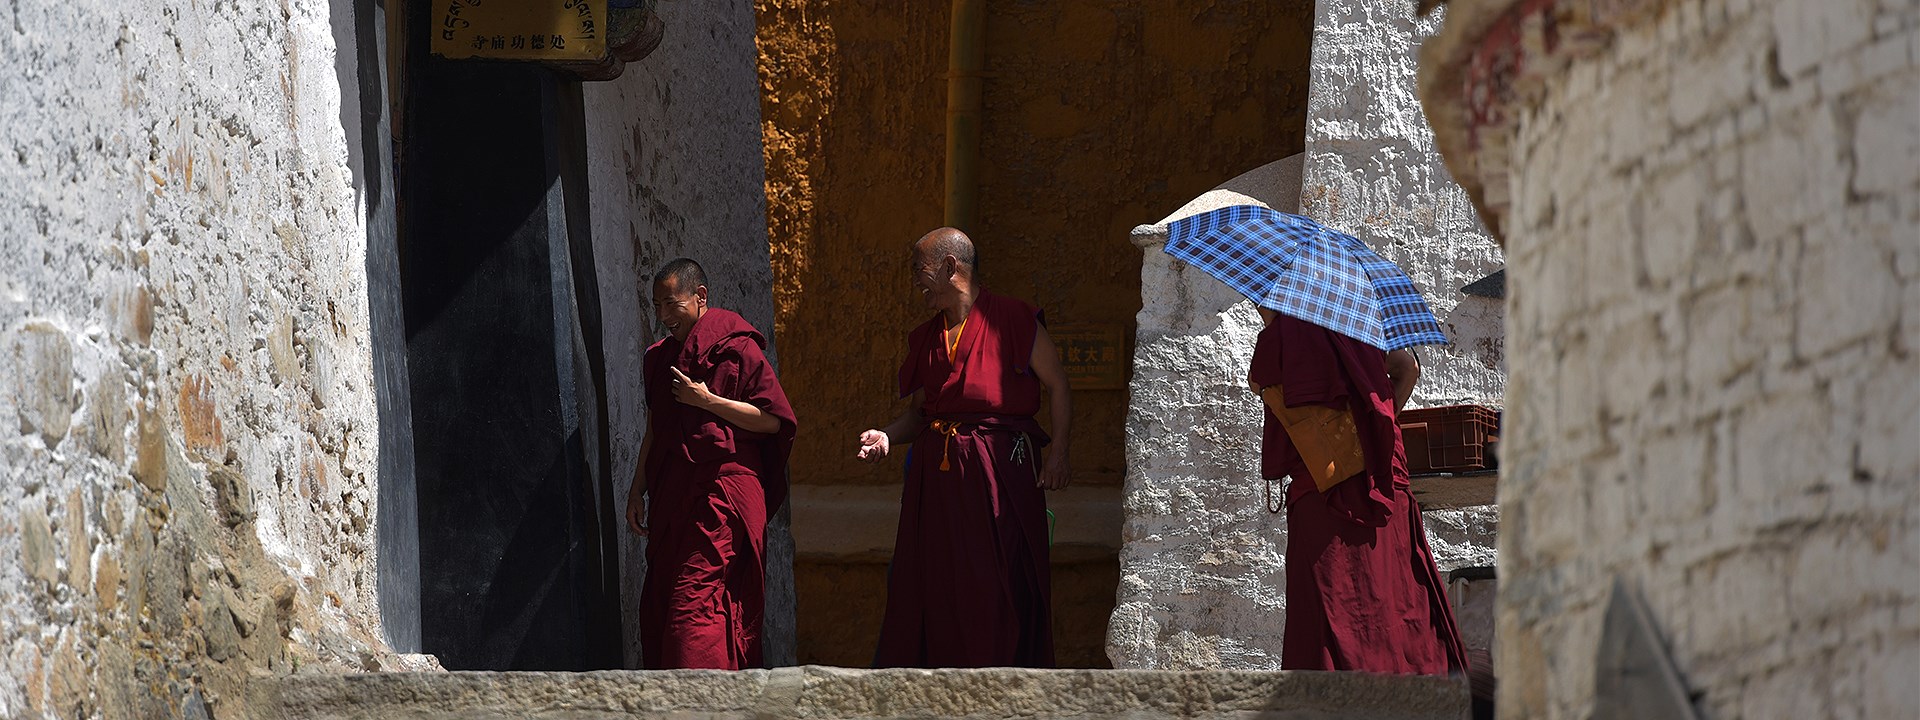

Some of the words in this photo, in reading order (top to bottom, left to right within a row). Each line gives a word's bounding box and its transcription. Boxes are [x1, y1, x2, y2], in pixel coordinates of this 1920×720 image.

[471, 34, 566, 50] 寺庙功德处
